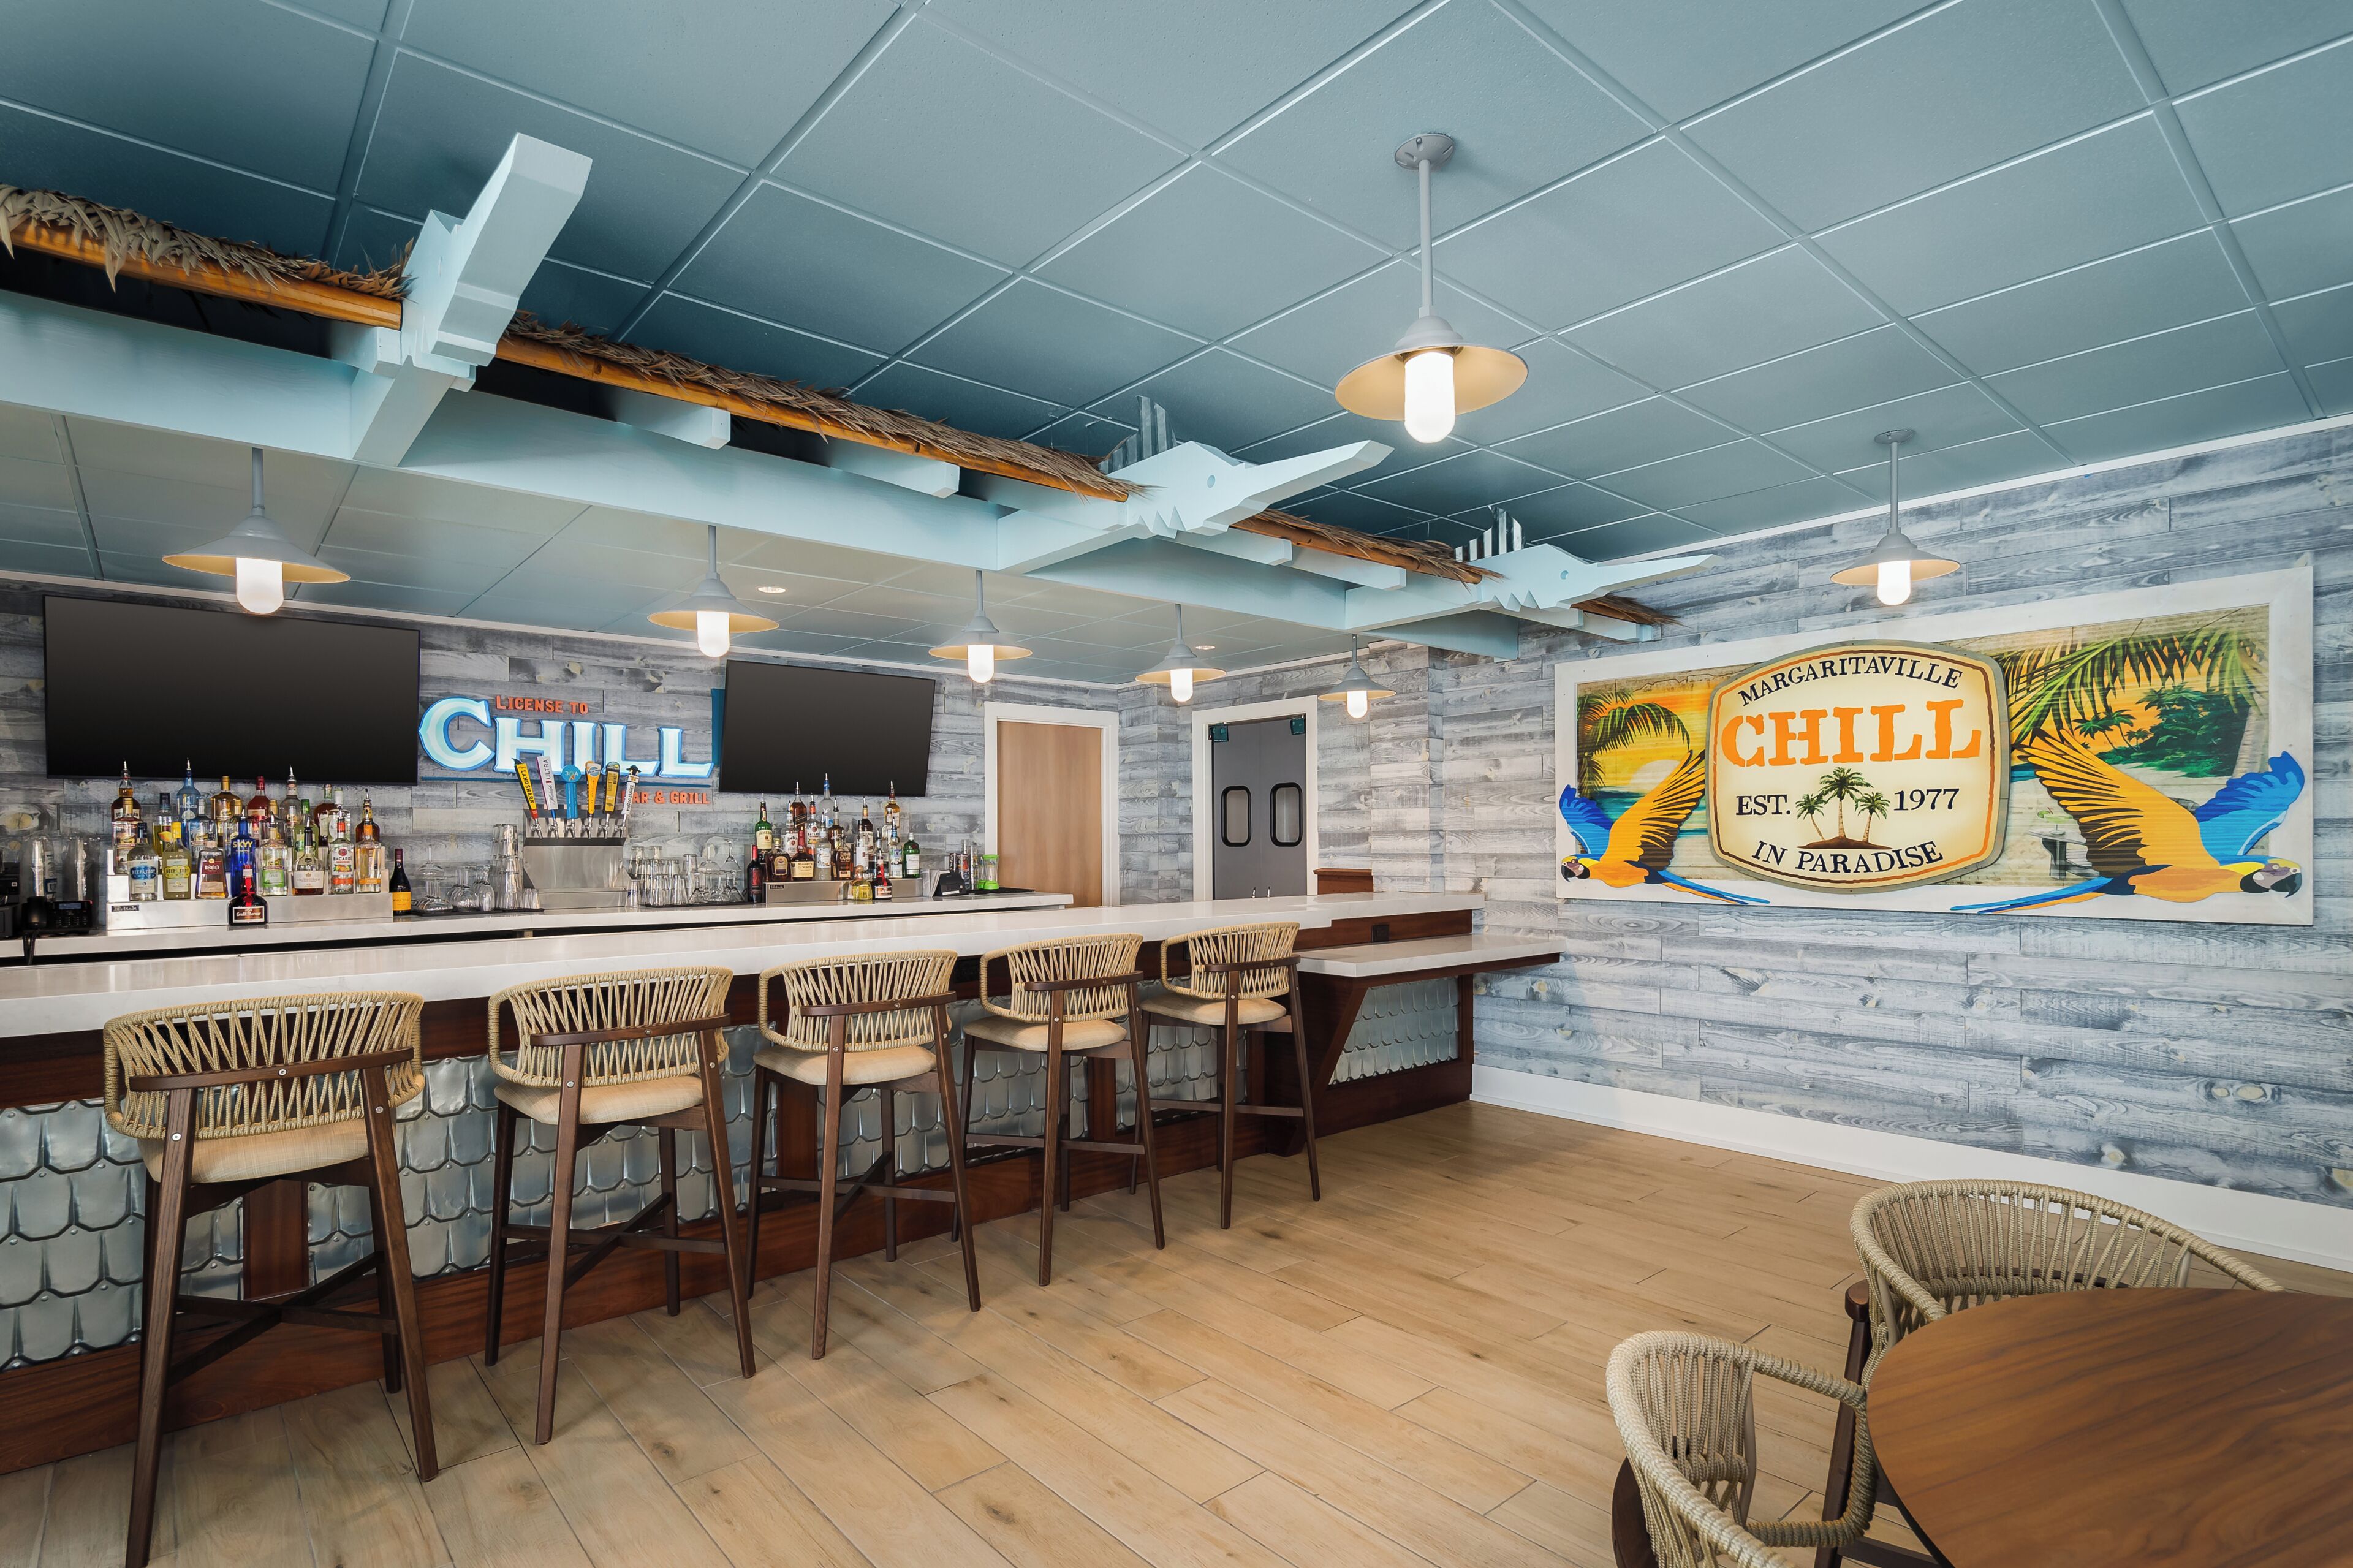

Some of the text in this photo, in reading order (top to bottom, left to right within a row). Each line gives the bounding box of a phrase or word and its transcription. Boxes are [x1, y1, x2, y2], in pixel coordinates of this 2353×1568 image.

[1738, 656, 1963, 706] MARGARITAVILLE
[495, 695, 589, 714] LICENSE TO
[419, 696, 713, 778] CHILL
[1721, 699, 1982, 767] CHILL
[543, 759, 551, 780] ULTRA
[521, 770, 534, 804] LANDSHARK
[654, 790, 665, 804] &
[670, 790, 710, 805] GRILL
[1735, 788, 1960, 816] EST. 1977
[1751, 840, 1943, 873] IN PARADISE
